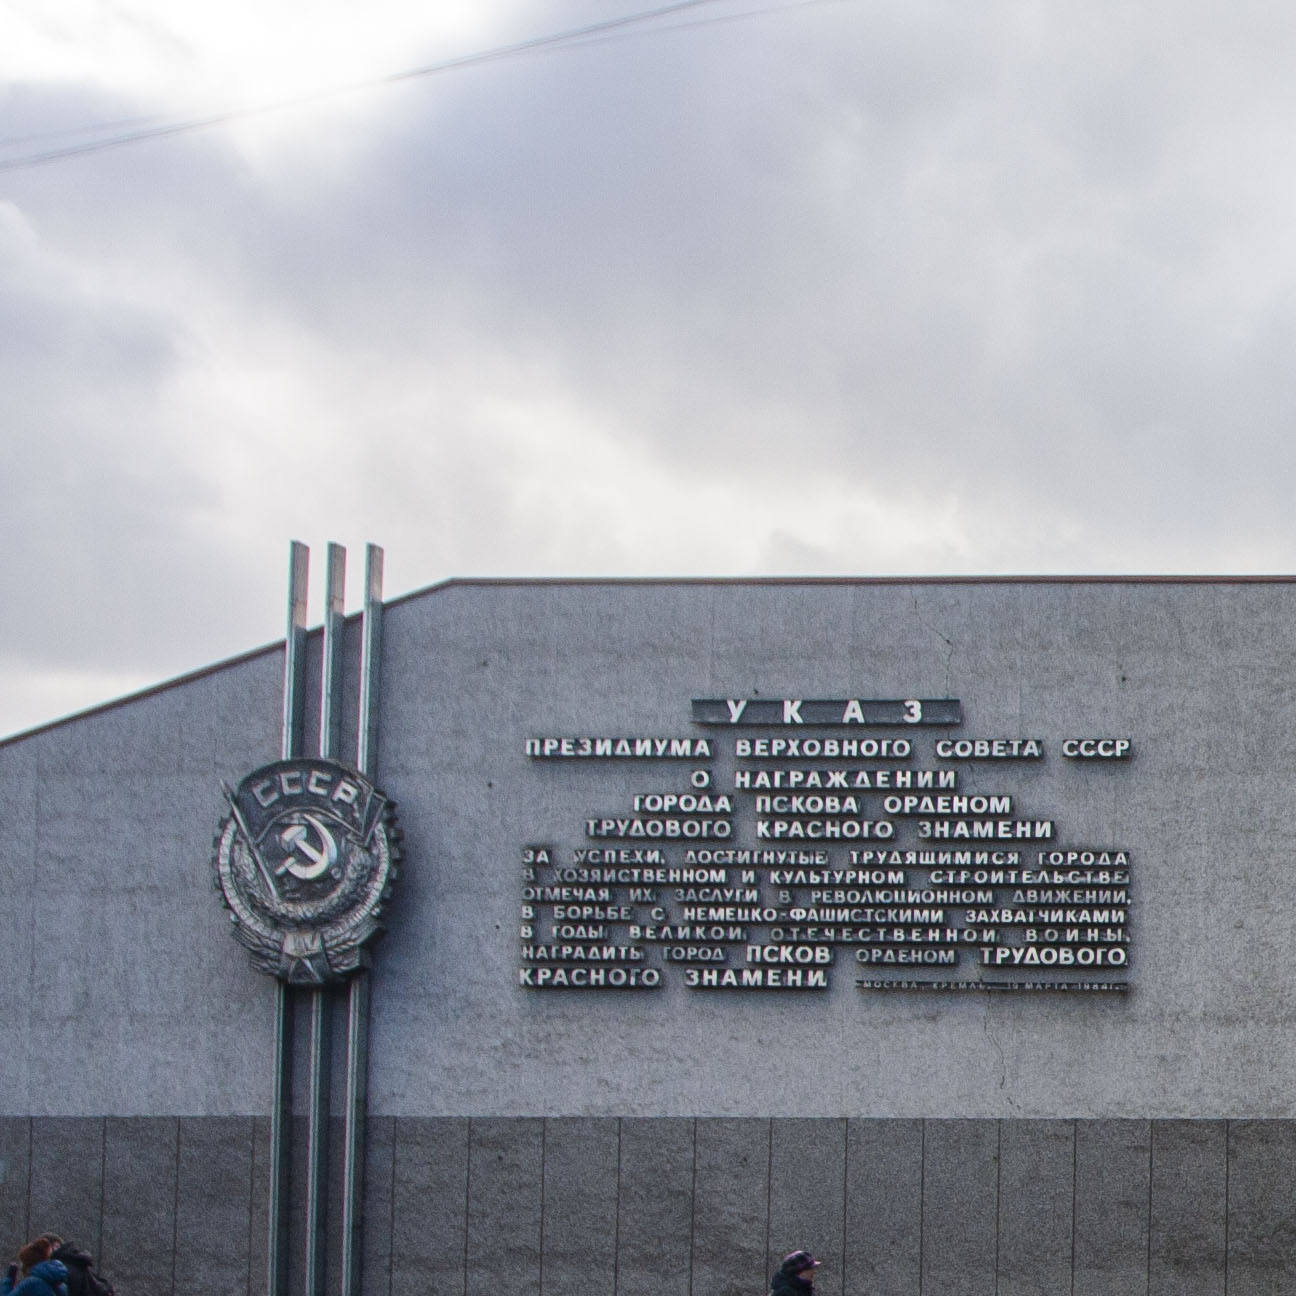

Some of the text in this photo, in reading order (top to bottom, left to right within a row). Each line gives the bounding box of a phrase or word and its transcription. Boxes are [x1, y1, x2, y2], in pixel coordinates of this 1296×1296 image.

[525, 738, 1130, 758] ПРЕЗИДИУМА ВЕРХОВНОГО СОВЕТА СССР
[252, 767, 359, 808] СССР
[690, 770, 956, 789] О НАГРАЖДЕНИИ
[633, 794, 1011, 814] ГОРОДА ПСКОВА ОРДЕНОМ
[586, 819, 1052, 838] ТРУДОВОГО КРАСНОГО ЗНАМЕНИ
[523, 850, 549, 864] ЗА
[686, 850, 827, 865] ДОСТИГНУТЫЕ
[1038, 851, 1128, 866] ГОРОДА
[741, 870, 755, 883] И
[770, 870, 905, 884] КУЛЬТУРНОМ
[929, 870, 1126, 885] СТРОИТЕЛЬСТВЕ
[522, 887, 610, 902] ОТМЕЧАЯ
[629, 888, 652, 902] ИХ
[674, 888, 758, 903] ЗАСЛУГИ
[779, 890, 791, 904] В
[811, 889, 993, 904] РЕВОЛЮЦИОННОМ
[521, 905, 1125, 923] В БОРЬБЕ С НЕМЕЦКО-ФАШИСТСКИМИ ЗАХВАТЧИКАМИ
[520, 925, 533, 939] В
[552, 925, 603, 939] ГОДЫ
[522, 945, 1126, 965] НАГРАДИТЬ ГОРОД ПСКОВ ОРДЕНОМ ТРУДОВОГО
[519, 967, 660, 986] КРАСНОГО
